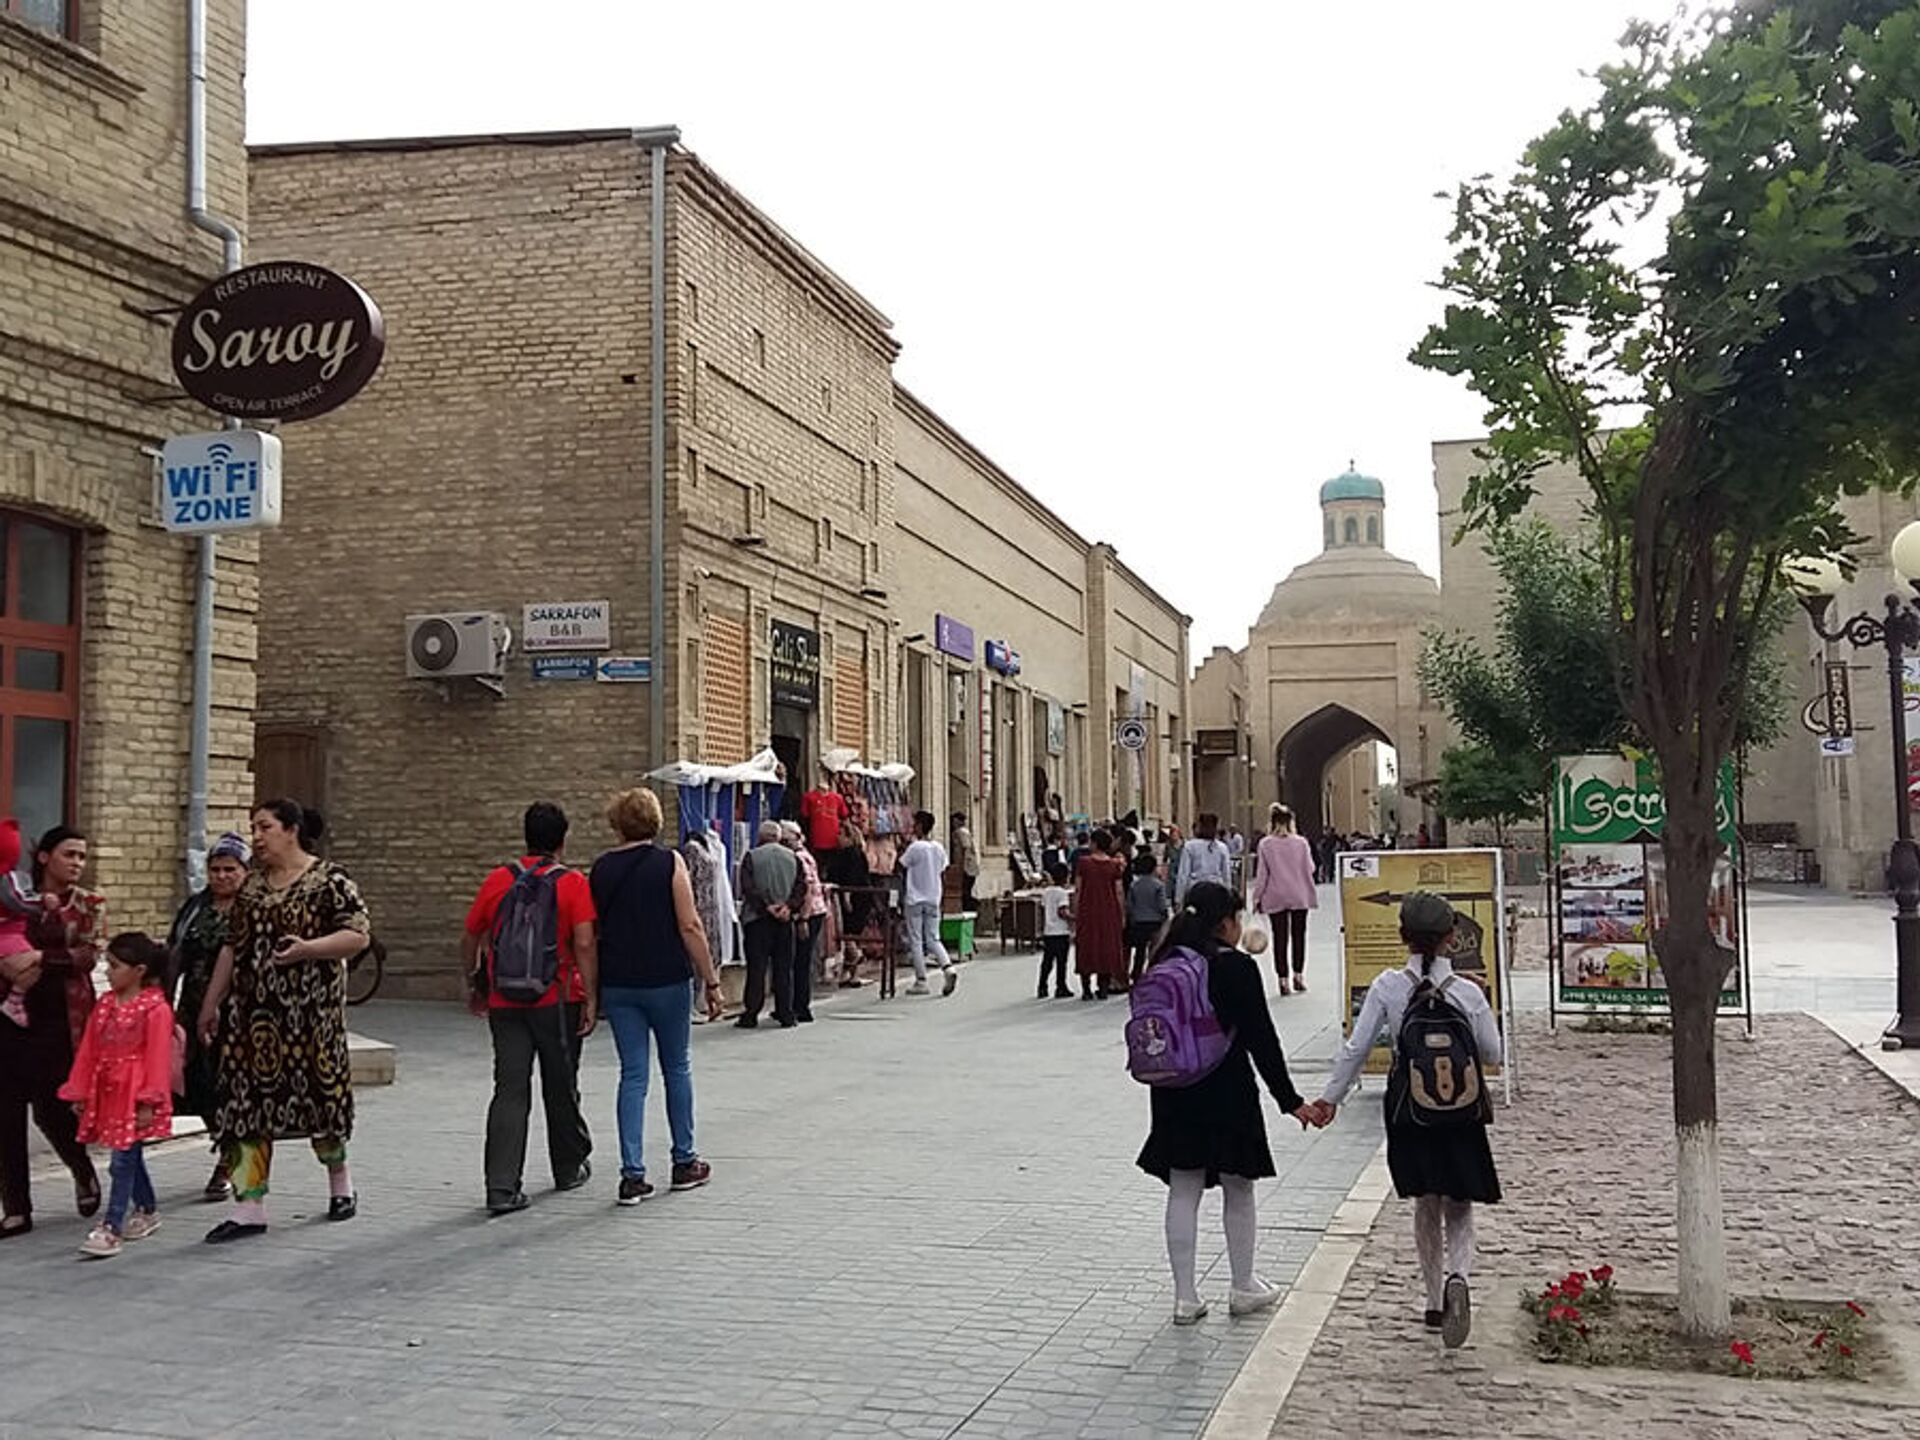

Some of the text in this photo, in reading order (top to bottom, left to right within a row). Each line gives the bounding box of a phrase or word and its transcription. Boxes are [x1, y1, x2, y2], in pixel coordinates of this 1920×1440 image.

[215, 268, 328, 301] RESTAURANT
[183, 309, 359, 380] Saroy
[175, 497, 251, 524] ZONE
